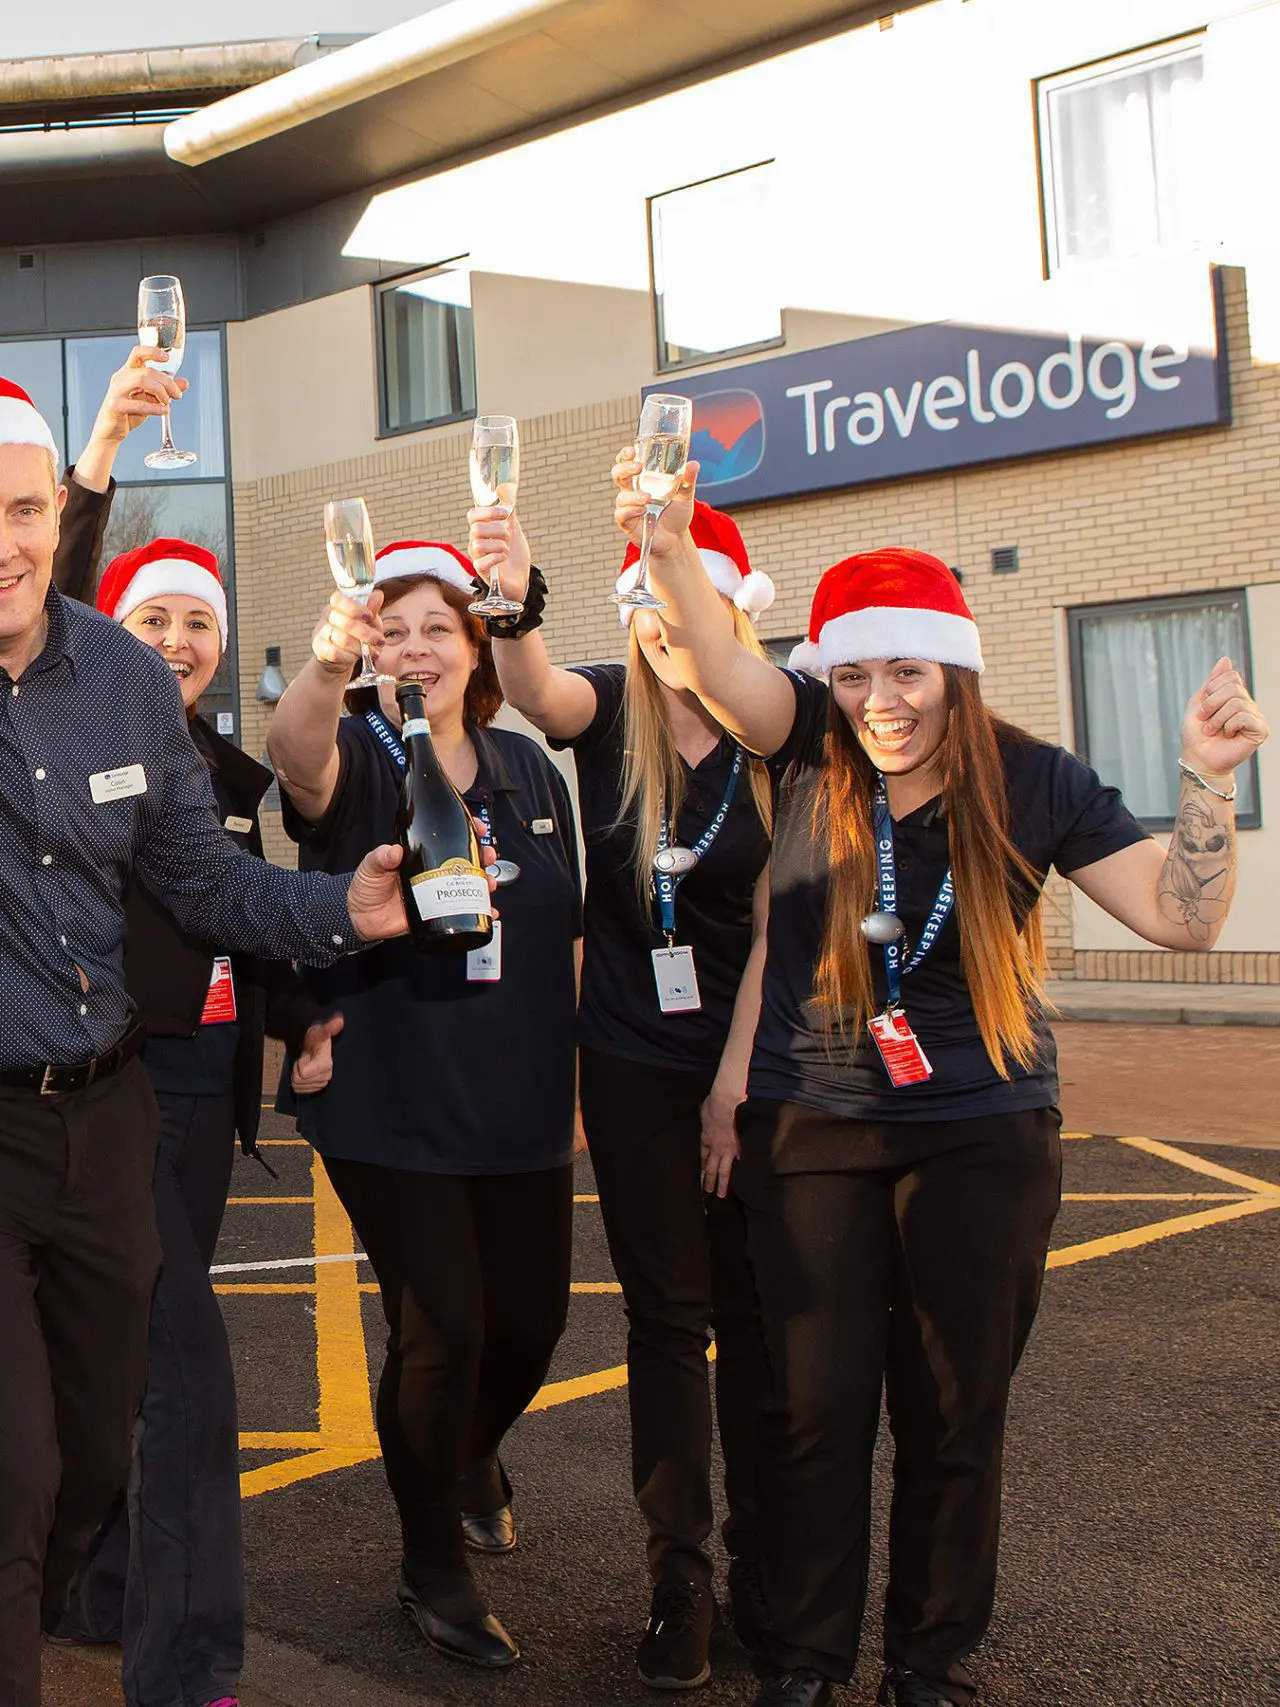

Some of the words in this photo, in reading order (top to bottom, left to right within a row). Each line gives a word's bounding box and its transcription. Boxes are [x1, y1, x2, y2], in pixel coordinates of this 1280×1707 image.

[786, 332, 1189, 455] Travelodge
[436, 888, 484, 900] PROSECCO
[879, 839, 899, 969] HOKEEPING
[902, 869, 954, 975] USEKEEPING
